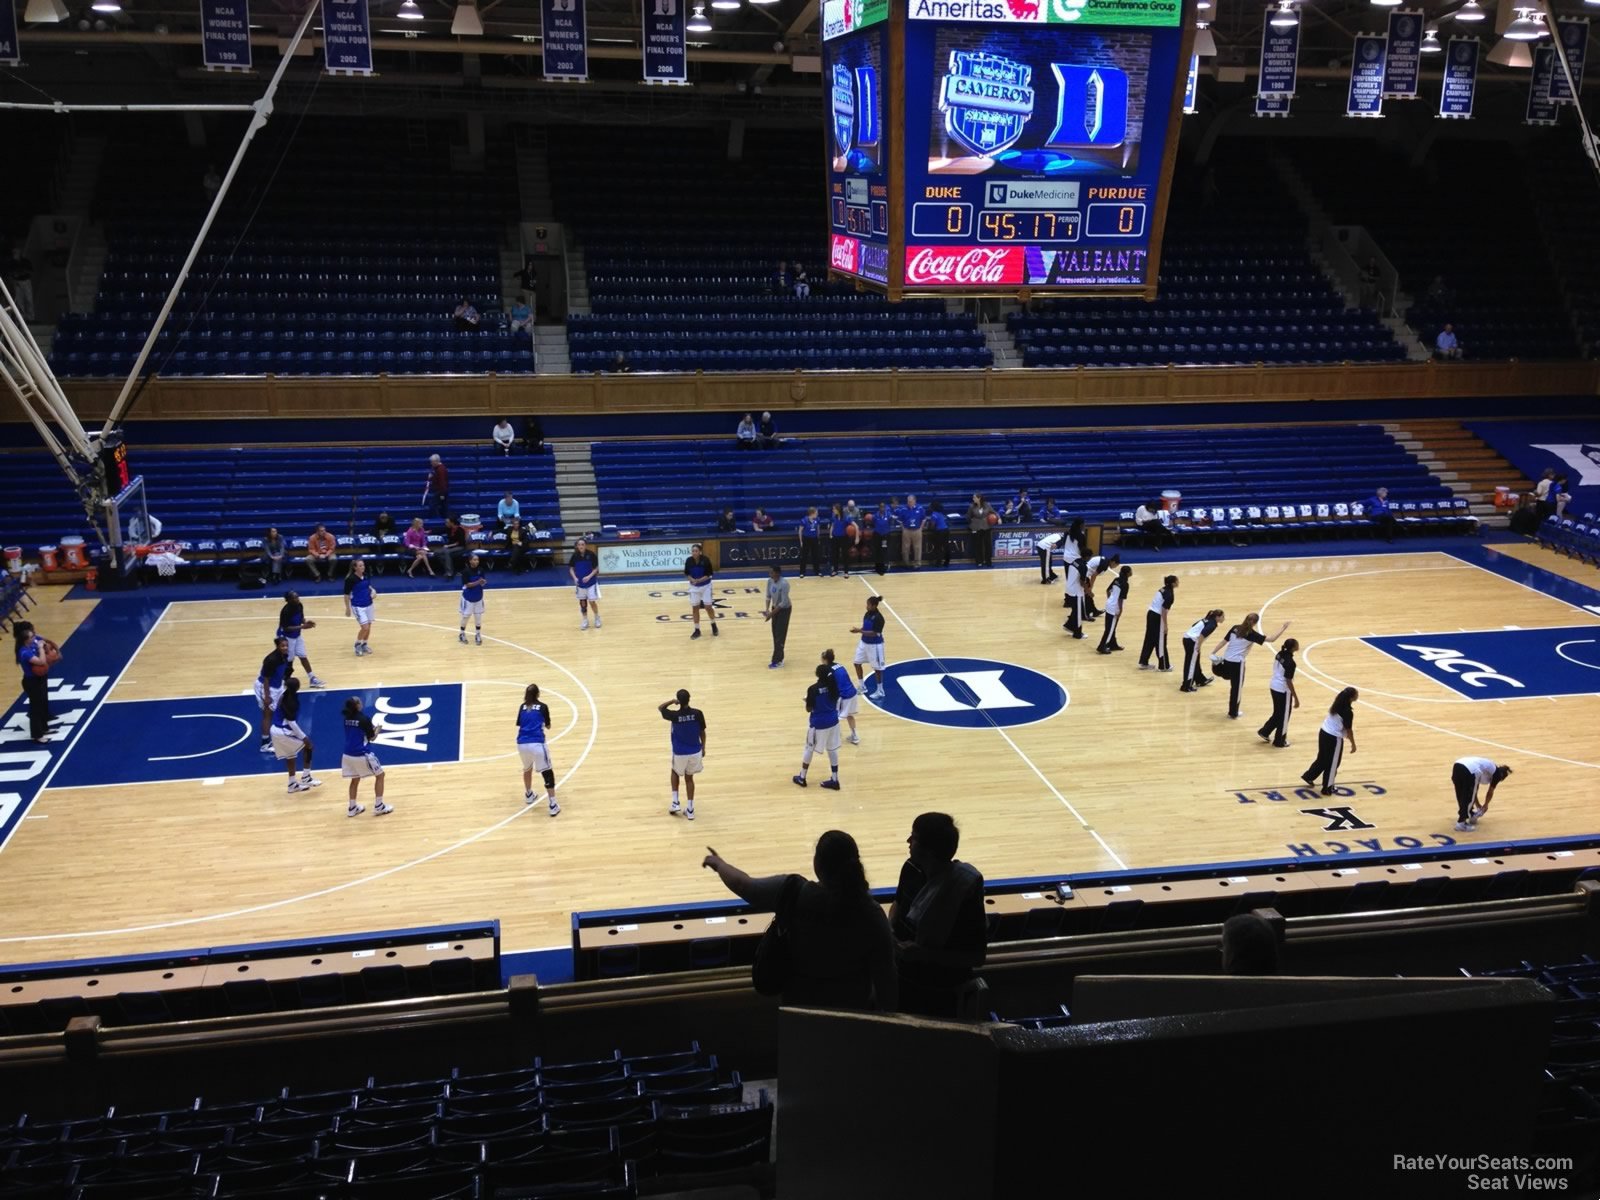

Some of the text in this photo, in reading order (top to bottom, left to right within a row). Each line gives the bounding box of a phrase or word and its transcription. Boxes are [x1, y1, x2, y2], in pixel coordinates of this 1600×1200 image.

[1150, 1, 1176, 11] Group
[209, 20, 242, 28] WOMEN'S
[330, 24, 362, 32] WOMEN'S
[549, 30, 580, 39] WOMEN'S
[349, 36, 367, 44] FOUR
[955, 80, 1032, 104] CAMERON
[926, 187, 961, 198] DUKE
[1088, 188, 1147, 199] PURDUE
[947, 206, 962, 232] 0
[985, 214, 1056, 239] 45:17
[1118, 206, 1134, 232] 0
[908, 249, 1011, 282] Coca-Cola
[1057, 250, 1141, 271] VALEANT
[622, 548, 672, 559] Washington
[626, 560, 640, 568] Inn
[652, 558, 670, 567] Golf
[1397, 644, 1526, 688] ACC
[370, 696, 432, 752] ACC
[1298, 806, 1377, 832] K
[1286, 834, 1457, 856] COACH
